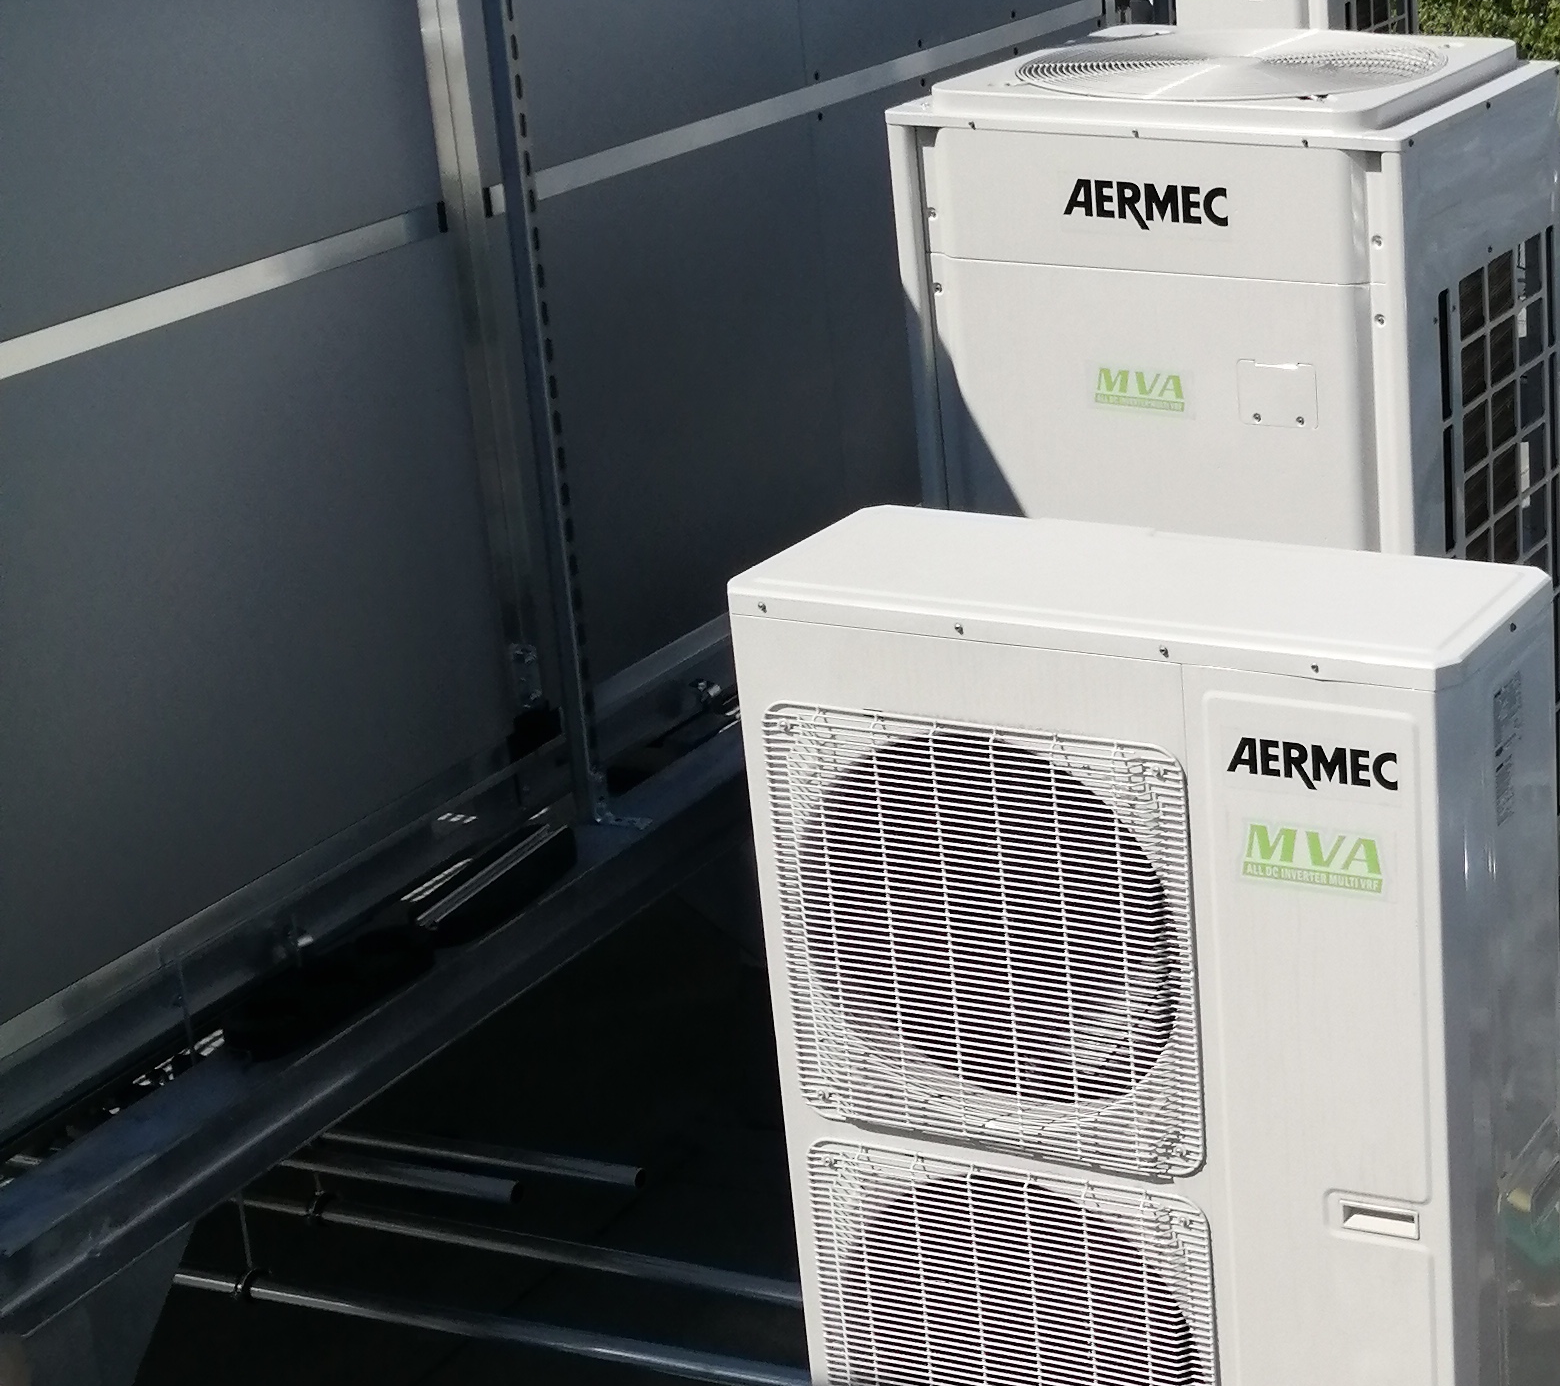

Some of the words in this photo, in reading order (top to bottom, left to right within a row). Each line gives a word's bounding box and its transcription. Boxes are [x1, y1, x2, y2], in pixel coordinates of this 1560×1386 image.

[1063, 178, 1228, 231] AERMEC
[1097, 368, 1184, 399] MVA
[1227, 736, 1398, 791] AERMEC
[1246, 824, 1381, 874] MVA
[1246, 863, 1263, 876] ALL
[1266, 866, 1278, 877] DC
[1281, 868, 1327, 884] INVERTER
[1329, 875, 1359, 889] MULTI
[1360, 878, 1379, 891] VRF
